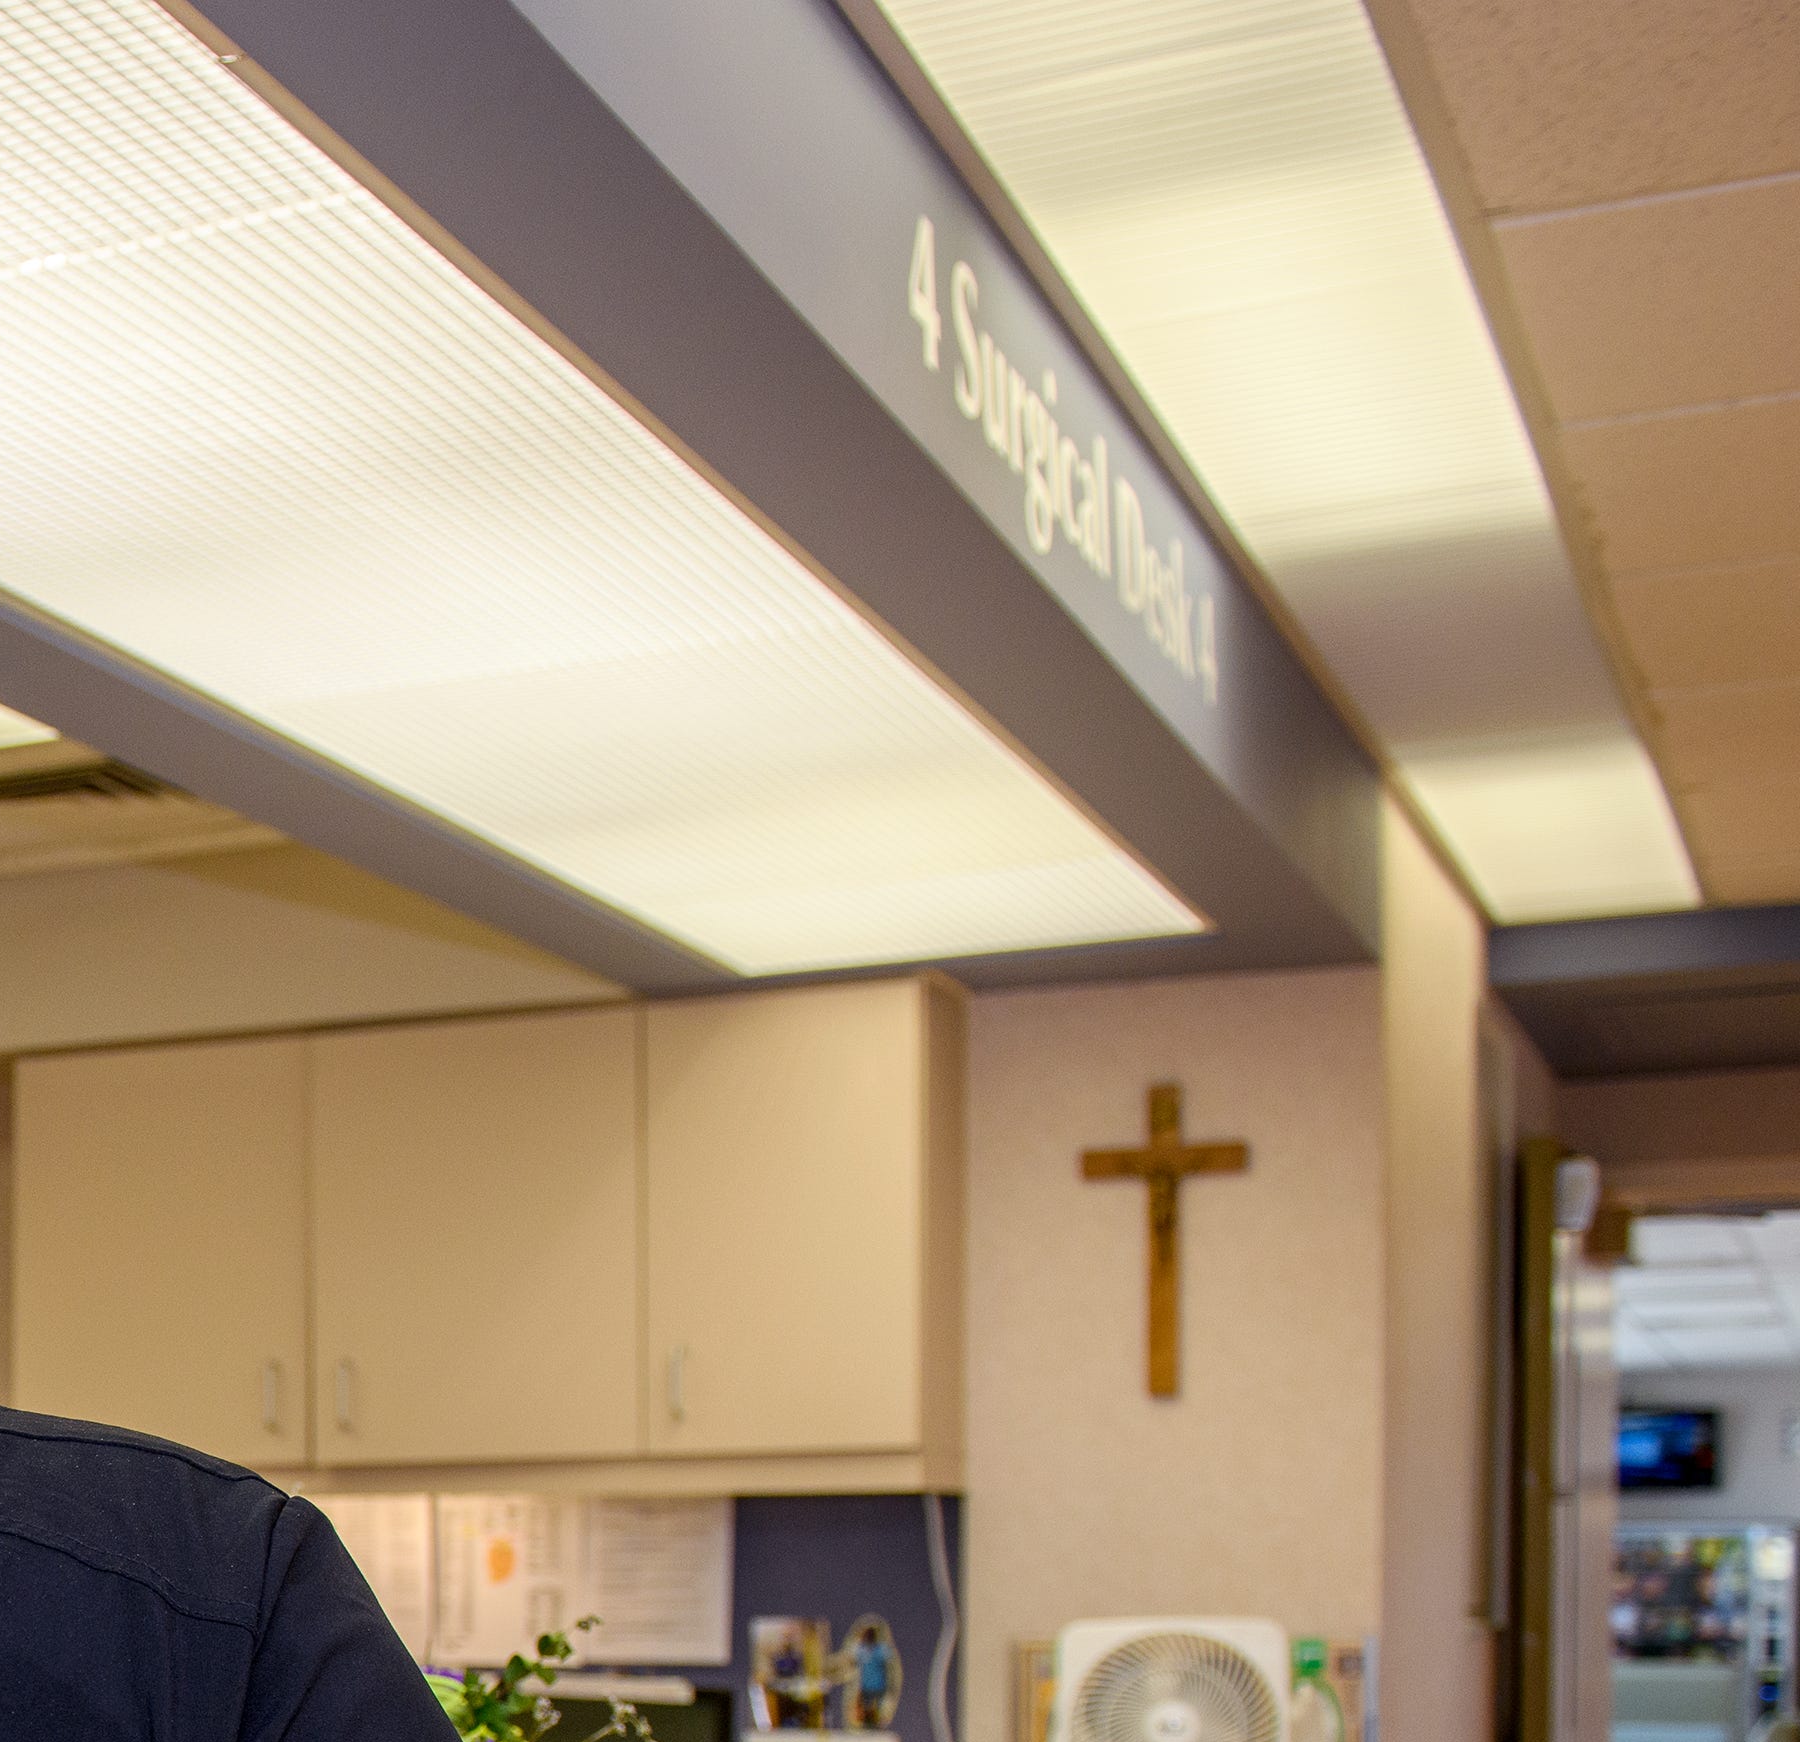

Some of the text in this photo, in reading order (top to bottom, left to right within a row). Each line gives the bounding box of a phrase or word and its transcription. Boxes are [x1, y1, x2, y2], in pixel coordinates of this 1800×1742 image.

[909, 214, 941, 371] 4
[951, 259, 1112, 579] Surgical
[1114, 475, 1196, 682] Desk
